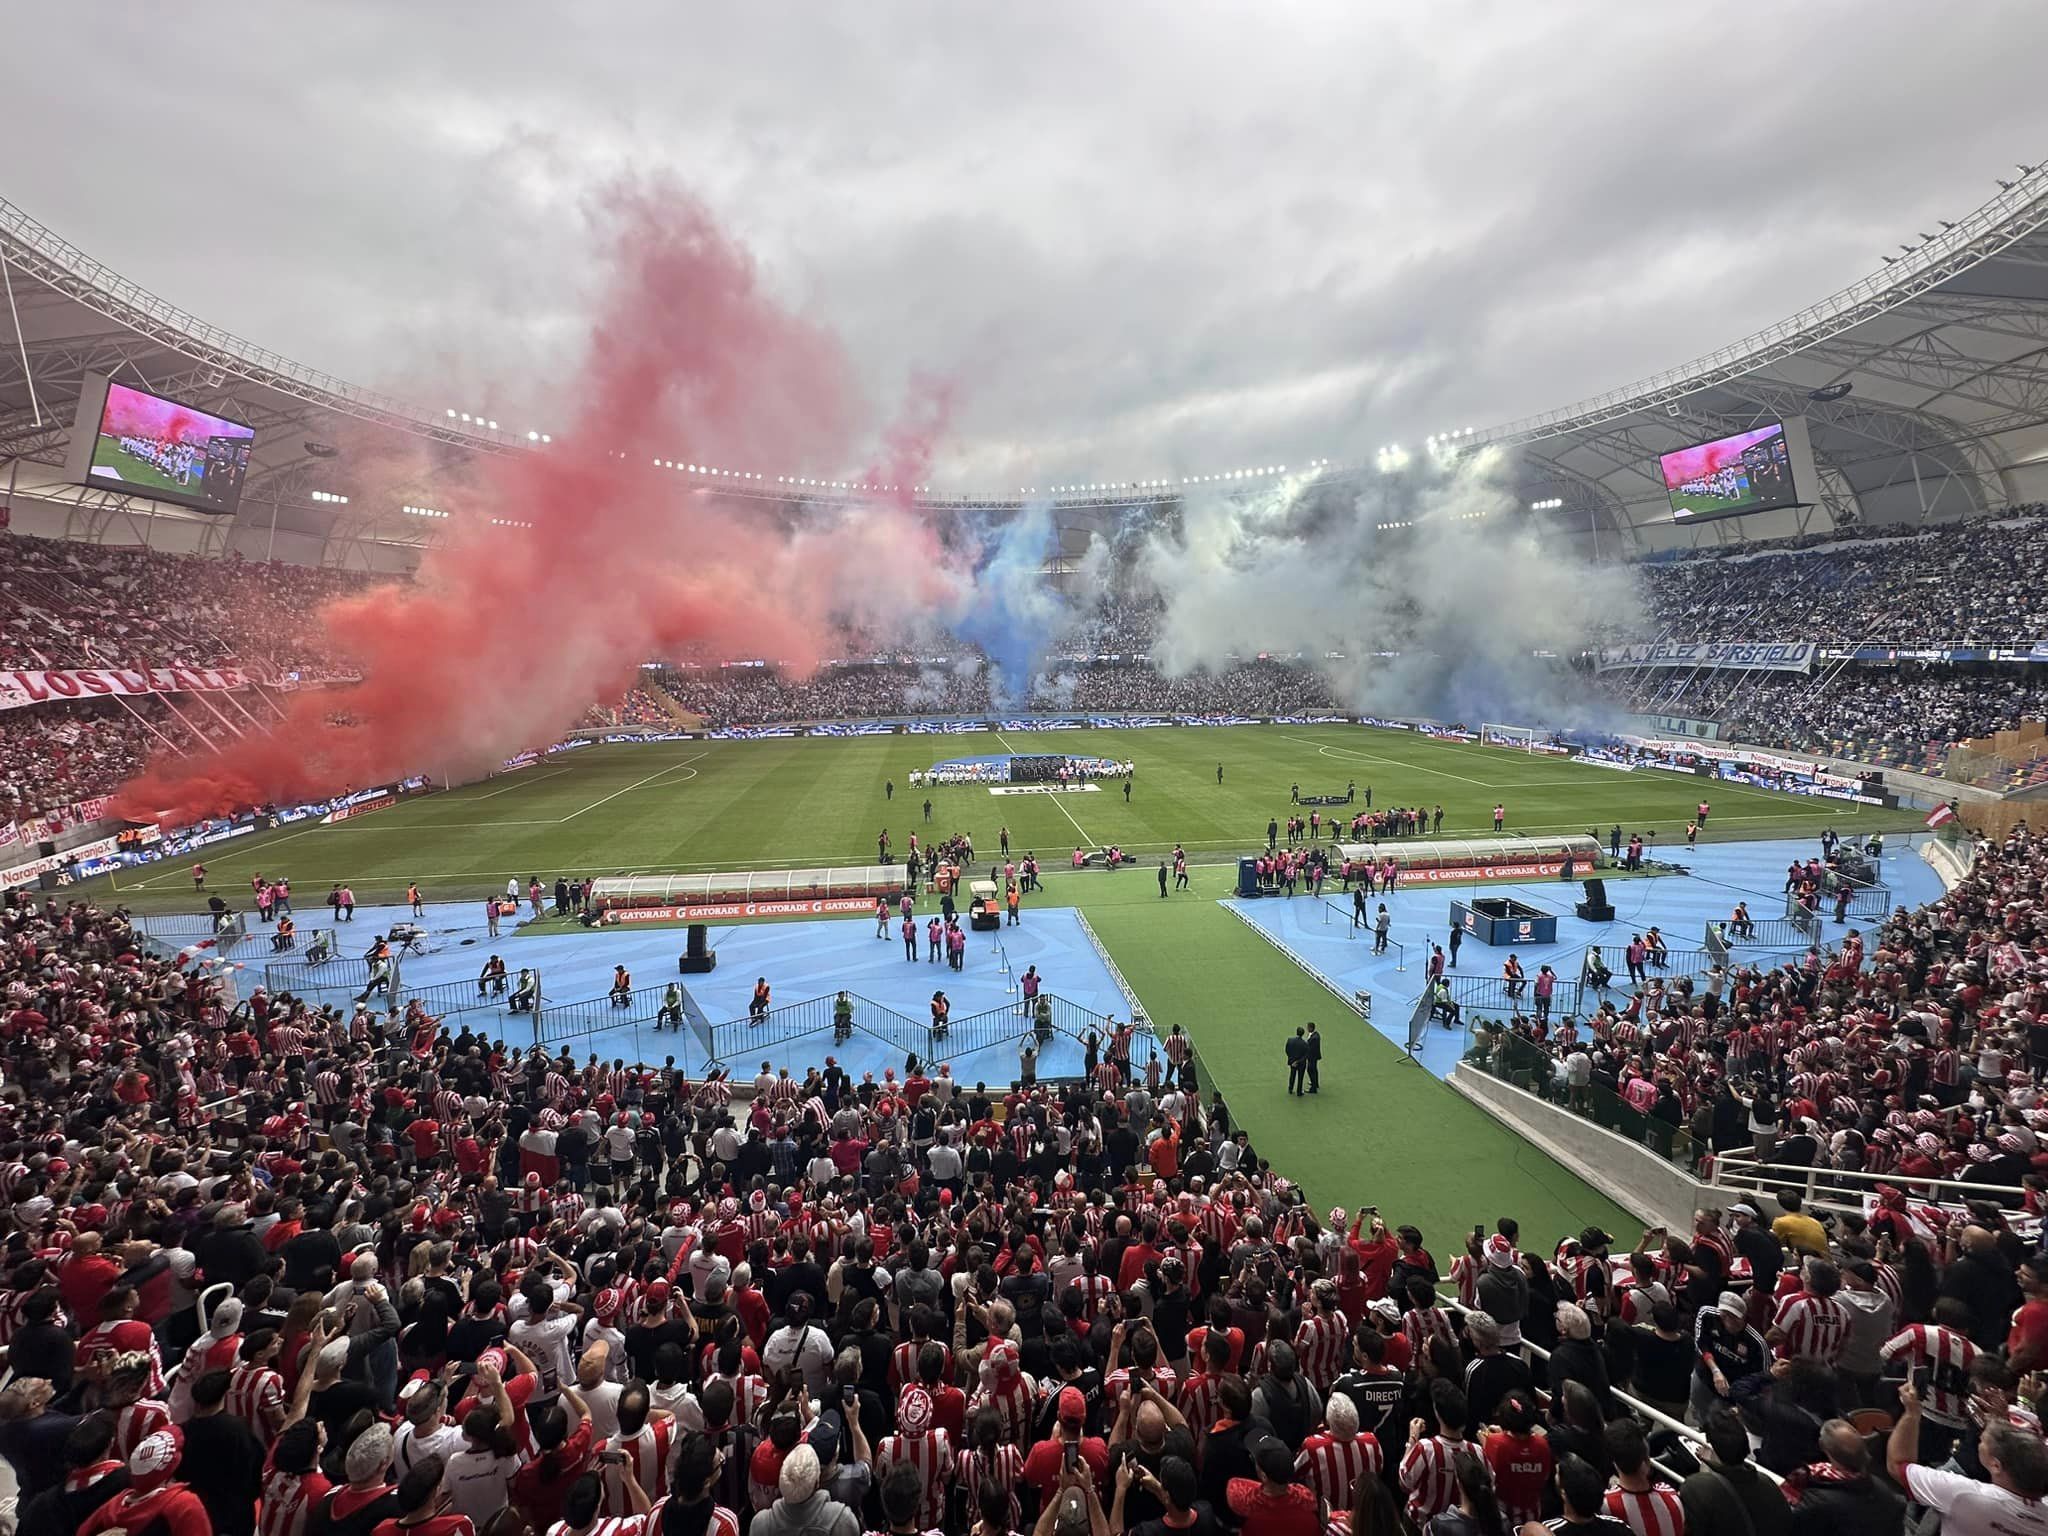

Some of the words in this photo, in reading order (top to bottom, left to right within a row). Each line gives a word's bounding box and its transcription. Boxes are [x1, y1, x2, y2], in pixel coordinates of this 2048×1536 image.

[1707, 644, 1811, 661] SARSFIELD
[13, 670, 113, 701] LOS
[109, 669, 256, 694] LEALE
[1705, 750, 1740, 760] aranjaX
[1723, 772, 1750, 784] Naldo
[283, 811, 307, 824] Naldo
[2, 857, 56, 885] NaranjaX
[80, 861, 122, 878] Naldo
[1428, 870, 1438, 880] G
[1439, 870, 1481, 880] GATORADE
[1485, 867, 1494, 878] G
[1495, 867, 1537, 876] GATORADE
[1539, 865, 1548, 875] G
[1550, 864, 1590, 874] GAADE
[620, 909, 672, 920] GATORADE
[676, 907, 686, 919] G
[689, 906, 740, 917] GATORADE
[746, 903, 756, 915] G
[759, 903, 808, 914] GATORADE
[812, 901, 822, 913] G
[825, 900, 873, 911] GATORADE
[1373, 1403, 1394, 1434] 7
